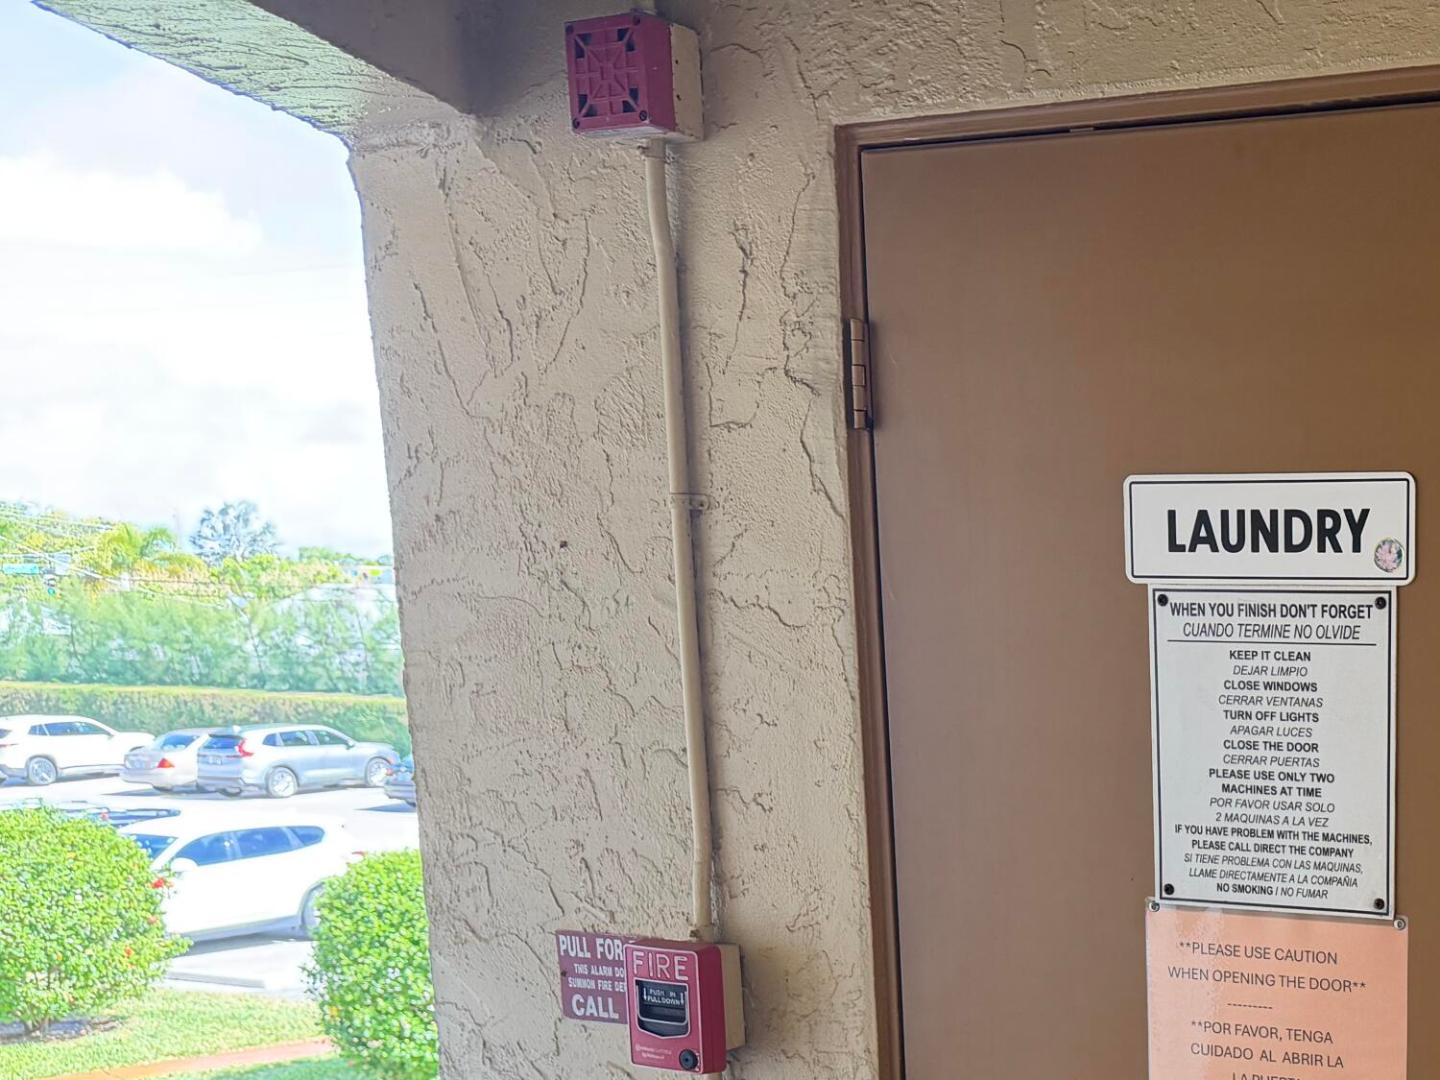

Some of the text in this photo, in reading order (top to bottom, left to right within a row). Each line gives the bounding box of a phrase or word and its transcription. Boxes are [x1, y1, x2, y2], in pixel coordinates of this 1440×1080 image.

[1167, 508, 1370, 554] LAUNDRY
[1170, 602, 1373, 619] WHEN YOU FINISH DON'T FORGET
[1183, 622, 1361, 640] CUANDO TERMINE NO OLVIDE
[1229, 650, 1311, 662] KEEP IT CLEAN
[1233, 665, 1308, 677] DEJAR LIMPIO
[1223, 680, 1318, 692] CLOSE WINDOWS
[1218, 695, 1323, 708] CERRAR VENTANAS
[1223, 710, 1319, 723] TURN OFF LIGHTS
[1230, 725, 1313, 738] APAGAR LUCES
[1223, 740, 1319, 753] CLOSE THE DOOR
[1223, 754, 1320, 768] CERRAR PUERTAS
[1209, 768, 1335, 784] PLEASE USE ONLY TWO
[1222, 784, 1322, 798] MACHINES AT TIME
[1209, 797, 1335, 813] POR FAVOR USAR SOLO
[1215, 812, 1329, 828] 2 MAQUINAS A LA VEZ
[1175, 824, 1373, 846] IF YOU HAVE PROBLEM WITH THE MACHINES,
[1191, 840, 1354, 858] PLEASE CALL DIRECT THE COMPANY
[1184, 853, 1193, 863] SI
[1195, 854, 1220, 865] TIENE
[1222, 856, 1270, 868] PROBLEMA
[1272, 858, 1293, 869] CON
[1294, 860, 1311, 871] LAS
[1189, 868, 1217, 879] LLAME
[1219, 869, 1287, 883] DIRECTAMENTE
[1288, 873, 1295, 883] A
[1297, 874, 1308, 884] LA
[1217, 882, 1230, 893] NO
[1231, 883, 1274, 896] SMOKING
[1280, 886, 1294, 897] NO
[1296, 888, 1329, 899] FUMAR
[558, 934, 624, 961] PULL FOR
[1244, 946, 1271, 960] USE
[1274, 948, 1338, 965] CAUTION
[574, 963, 588, 975] THIS
[591, 965, 613, 977] ALARM
[632, 950, 689, 981] FIRE
[568, 977, 595, 989] SUMMON
[598, 979, 613, 991] FIRE
[1167, 966, 1209, 981] WHEN
[1212, 970, 1276, 986] OPENING
[1279, 974, 1306, 989] THE
[571, 993, 619, 1019] CALL
[1235, 1024, 1283, 1042] FAVOR,
[1286, 1028, 1333, 1044] TENGA
[1190, 1043, 1344, 1069] CUIDADO AL ABRIR LA
